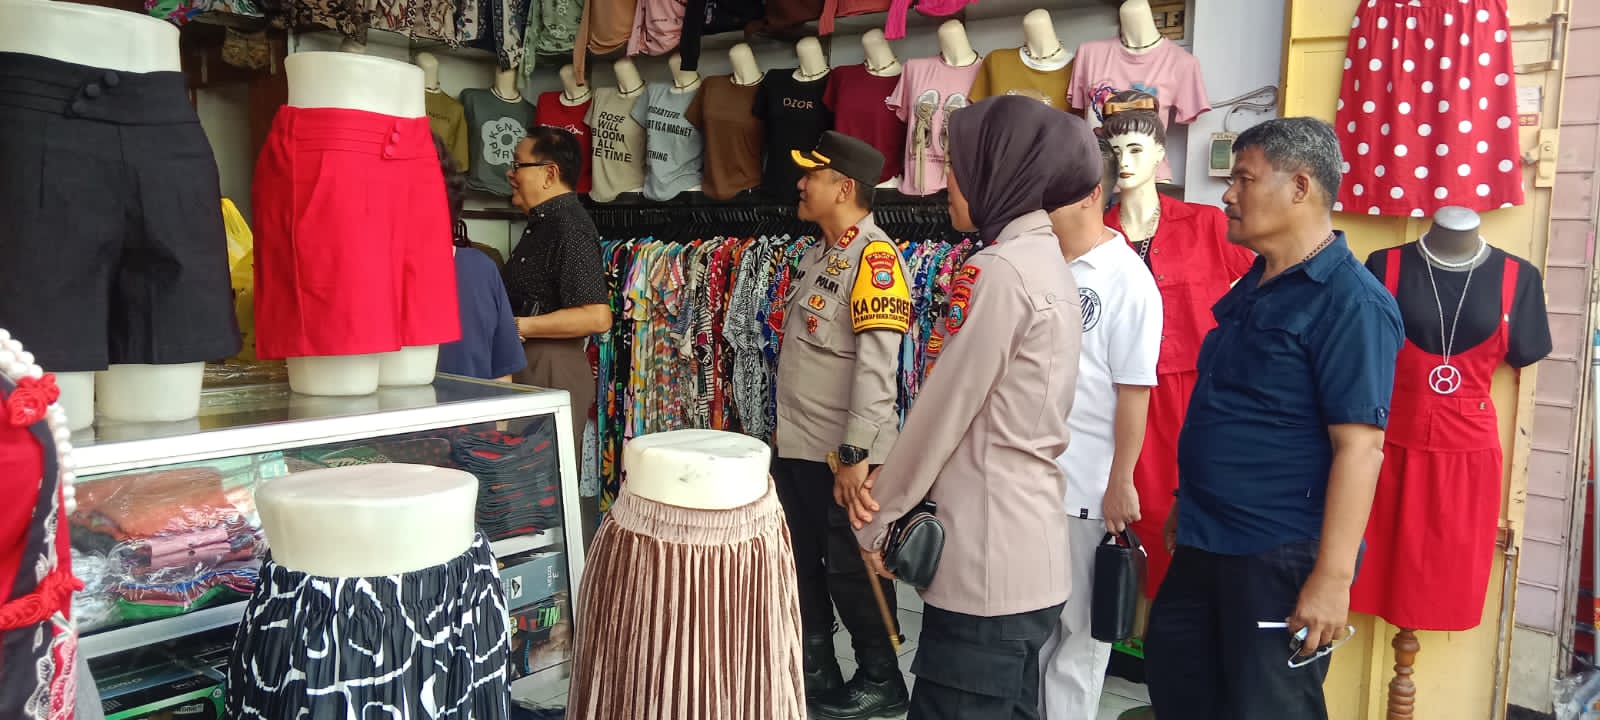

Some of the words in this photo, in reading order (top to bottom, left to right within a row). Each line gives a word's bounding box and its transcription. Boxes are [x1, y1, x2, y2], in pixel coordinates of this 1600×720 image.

[783, 97, 814, 109] DIOR
[599, 111, 625, 123] ROSE
[489, 123, 522, 140] KENZ
[598, 119, 619, 131] WILL
[667, 123, 692, 137] MAGNET
[592, 127, 625, 143] BLOOM
[597, 138, 615, 149] ALL
[604, 149, 633, 163] TIME
[648, 151, 668, 162] THING
[815, 275, 839, 294] POLRI
[853, 298, 869, 317] KA
[871, 296, 909, 318] OPSRES
